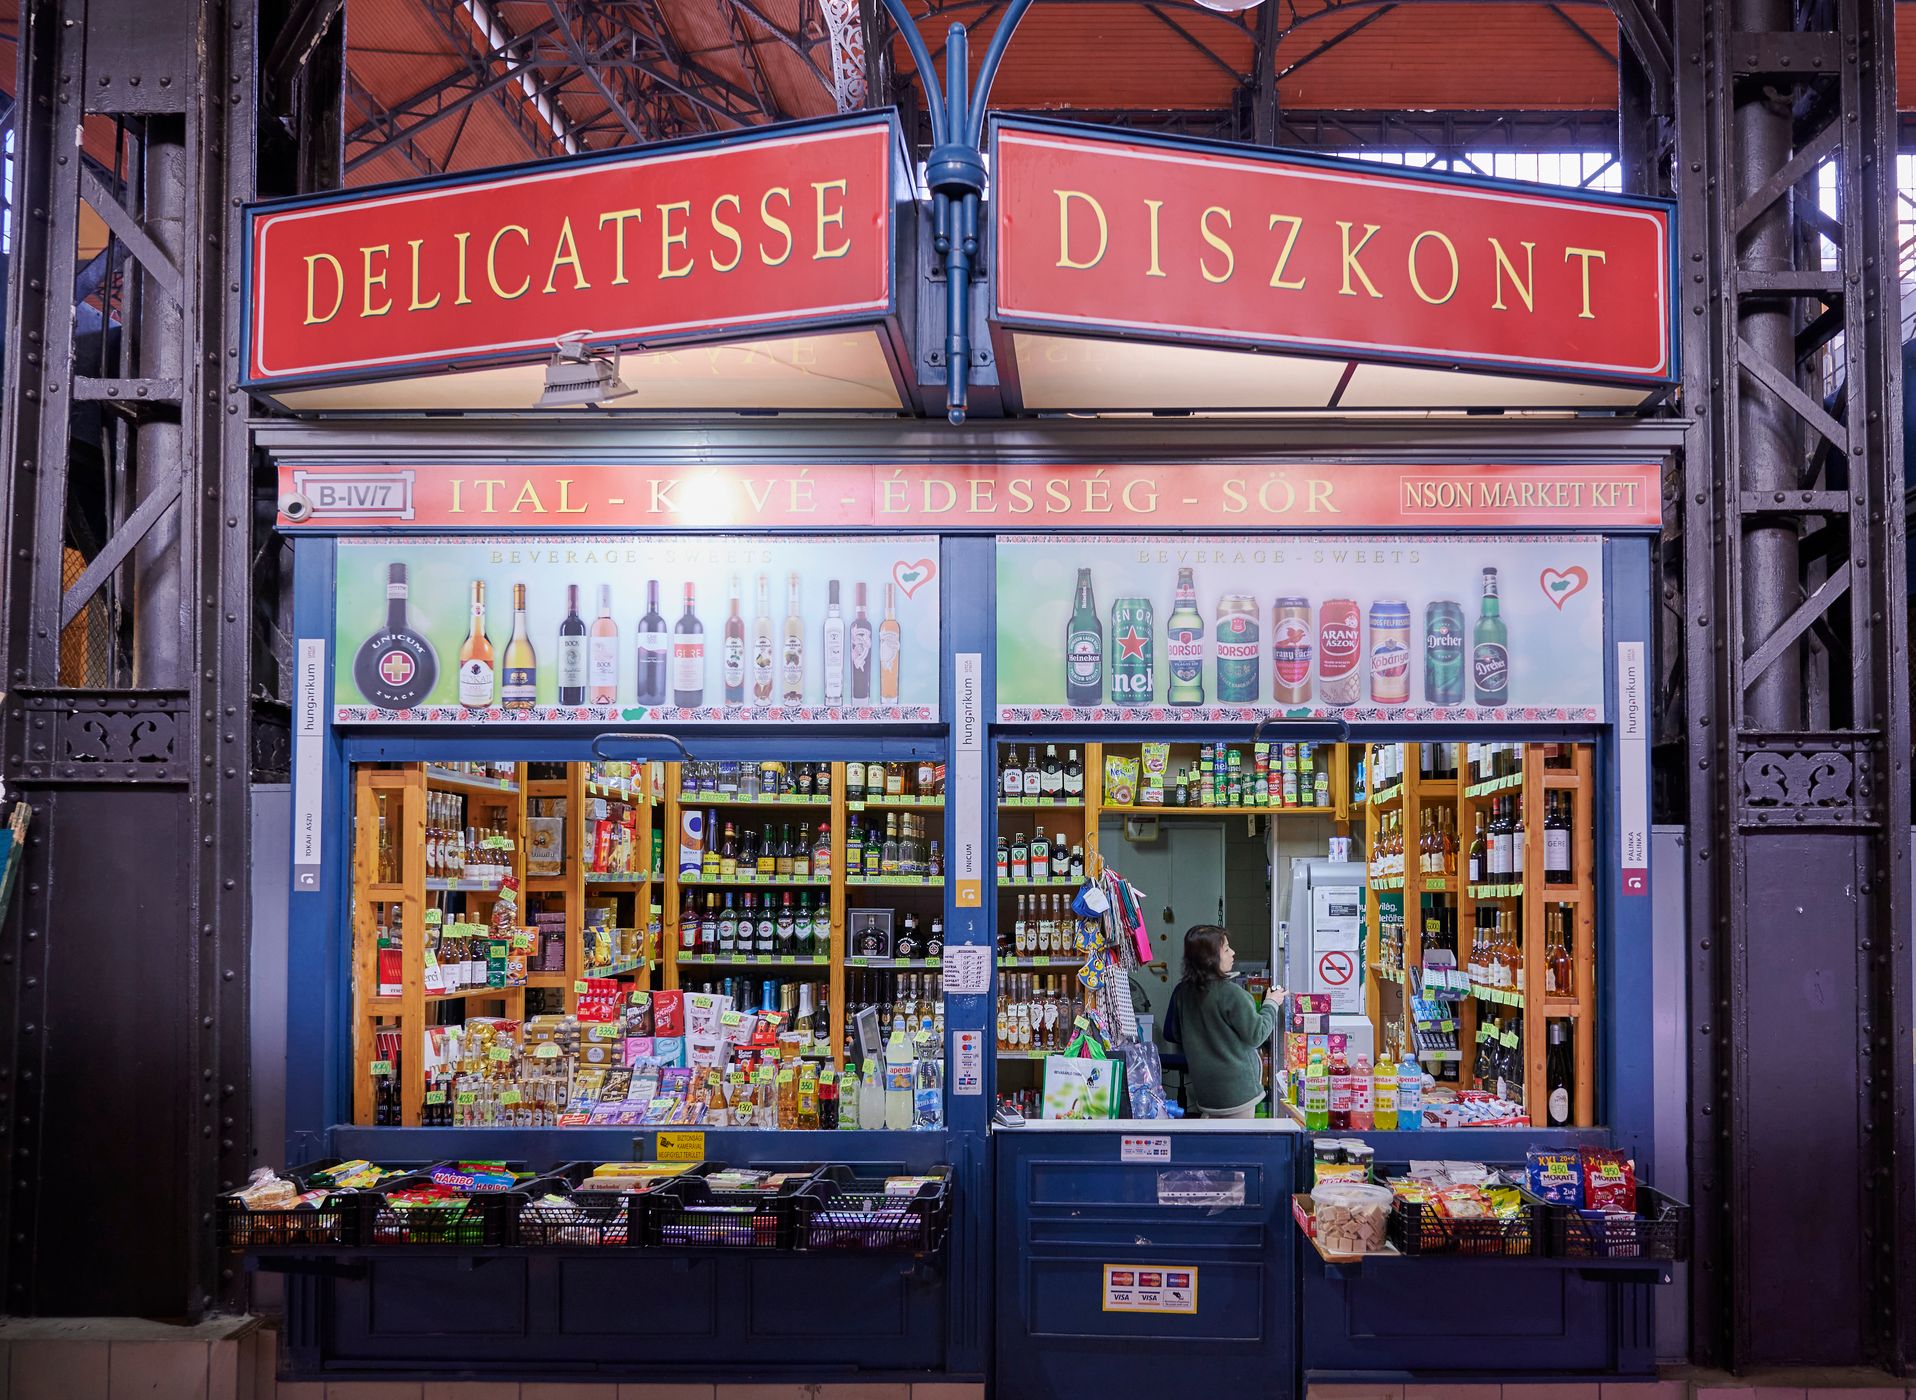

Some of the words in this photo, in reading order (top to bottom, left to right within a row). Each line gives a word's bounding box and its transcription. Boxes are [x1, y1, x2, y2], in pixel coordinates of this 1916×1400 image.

[302, 178, 852, 327] DELICATESSE
[1052, 188, 1607, 320] DISZKONT
[319, 485, 393, 508] B-IV/7
[449, 478, 589, 514] ITAL
[608, 497, 626, 505] -
[645, 468, 819, 514] KVÉ
[840, 497, 856, 505] -
[879, 468, 1161, 514] ÉDESSÉG
[1182, 497, 1198, 505] -
[1222, 471, 1342, 514] SÖR
[1405, 481, 1475, 509] NSON
[1480, 481, 1587, 508] MARKET
[1591, 481, 1640, 508] KFT
[489, 550, 638, 564] BEVERAGE
[664, 550, 774, 564] SWEETS
[1136, 550, 1286, 564] BEVERAGE
[1312, 550, 1421, 564] SWEETS
[1322, 630, 1359, 640] ARANY
[1427, 635, 1462, 648] Dreher
[371, 633, 426, 654] UNICUM
[1068, 654, 1101, 663] Heineken
[1475, 659, 1506, 676] Dreher
[304, 662, 318, 731] hungarikum
[375, 690, 416, 702] ZWACK
[1626, 665, 1640, 734] hungarikum
[962, 676, 977, 745] hungarikum
[1627, 831, 1635, 862] PÁLINKA
[1550, 1164, 1567, 1174] 950
[1603, 1166, 1620, 1176] 950
[434, 1172, 475, 1187] HARIBO
[1114, 1293, 1130, 1301] VISA
[1141, 1294, 1158, 1302] VISA
